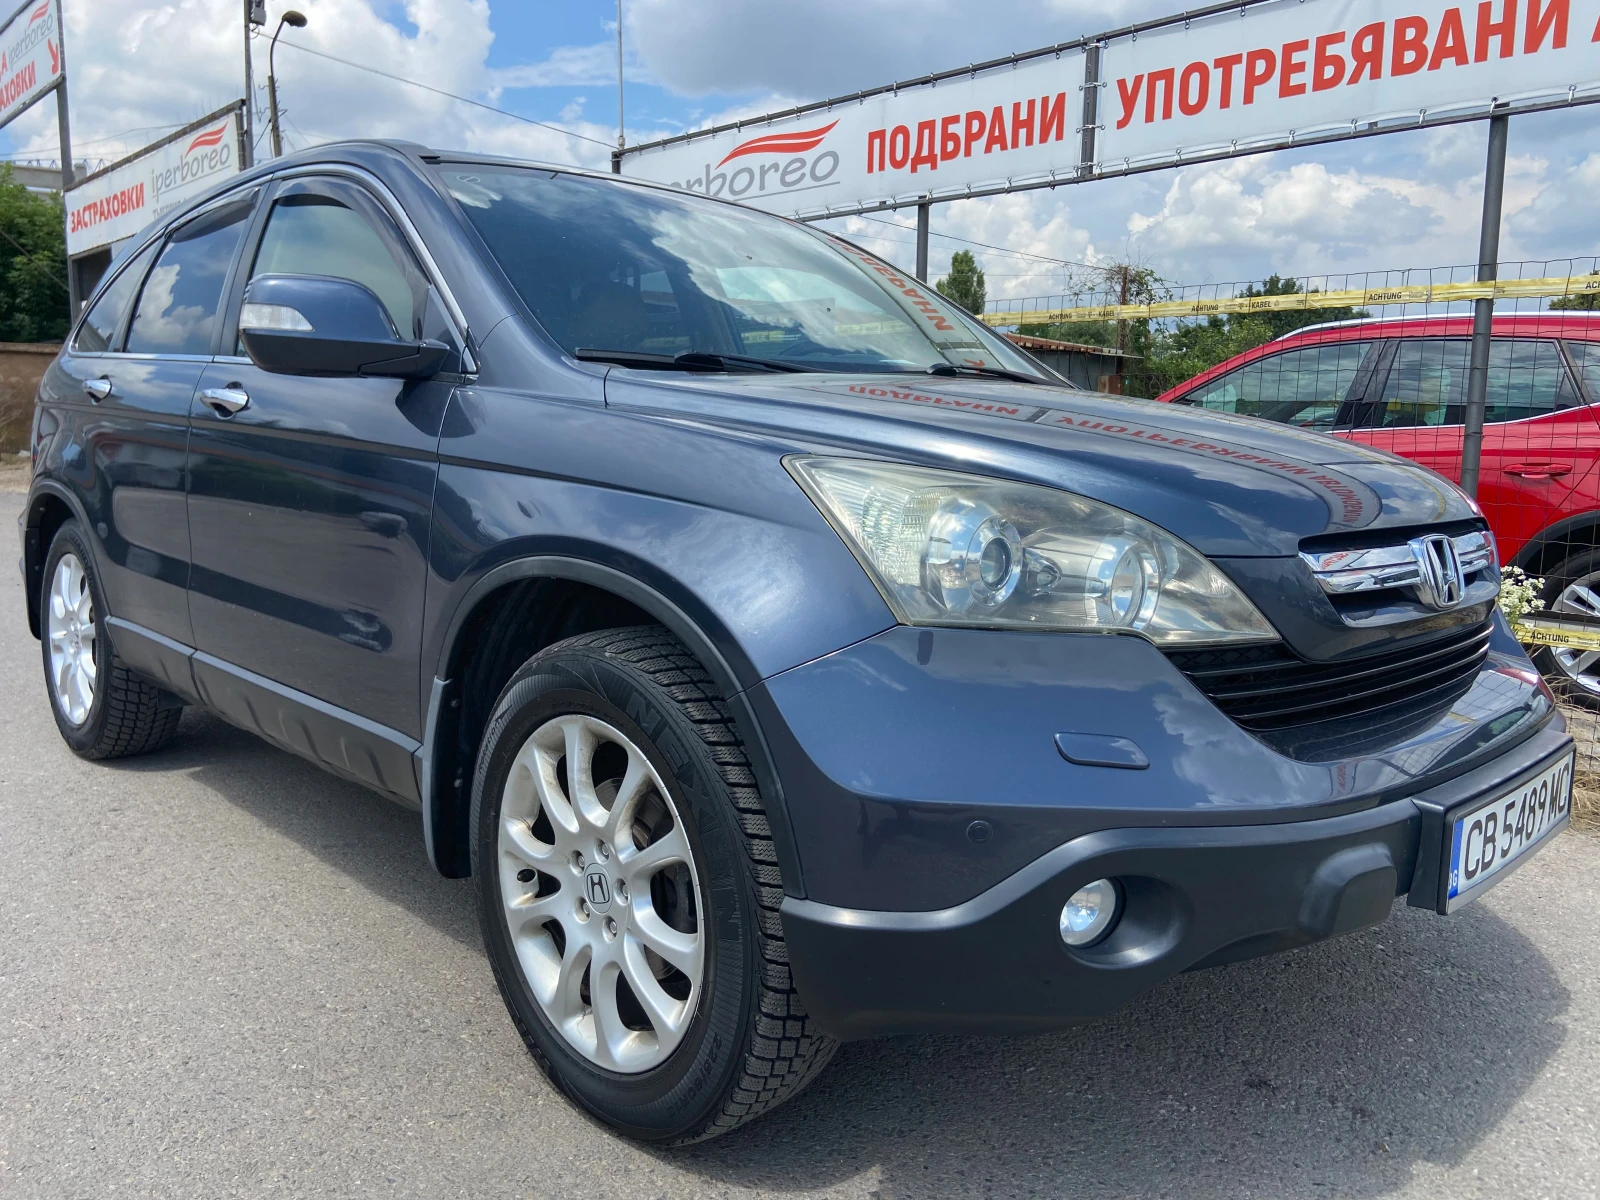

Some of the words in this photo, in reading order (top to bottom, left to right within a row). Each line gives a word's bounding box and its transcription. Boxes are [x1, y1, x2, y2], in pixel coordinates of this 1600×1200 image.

[1116, 0, 1570, 130] УПОТРЕБЯВАНИ
[866, 92, 1067, 174] ПОДБРАНИ
[151, 142, 231, 204] iperboreo
[669, 150, 840, 199] rboreo
[71, 182, 144, 233] ЗАСТРАХОВКИ
[1191, 304, 1219, 312] ACHTUNG
[1251, 301, 1272, 309] KABEL
[1368, 291, 1402, 301] ACHTUNG
[1530, 630, 1570, 643] ACHTUNG
